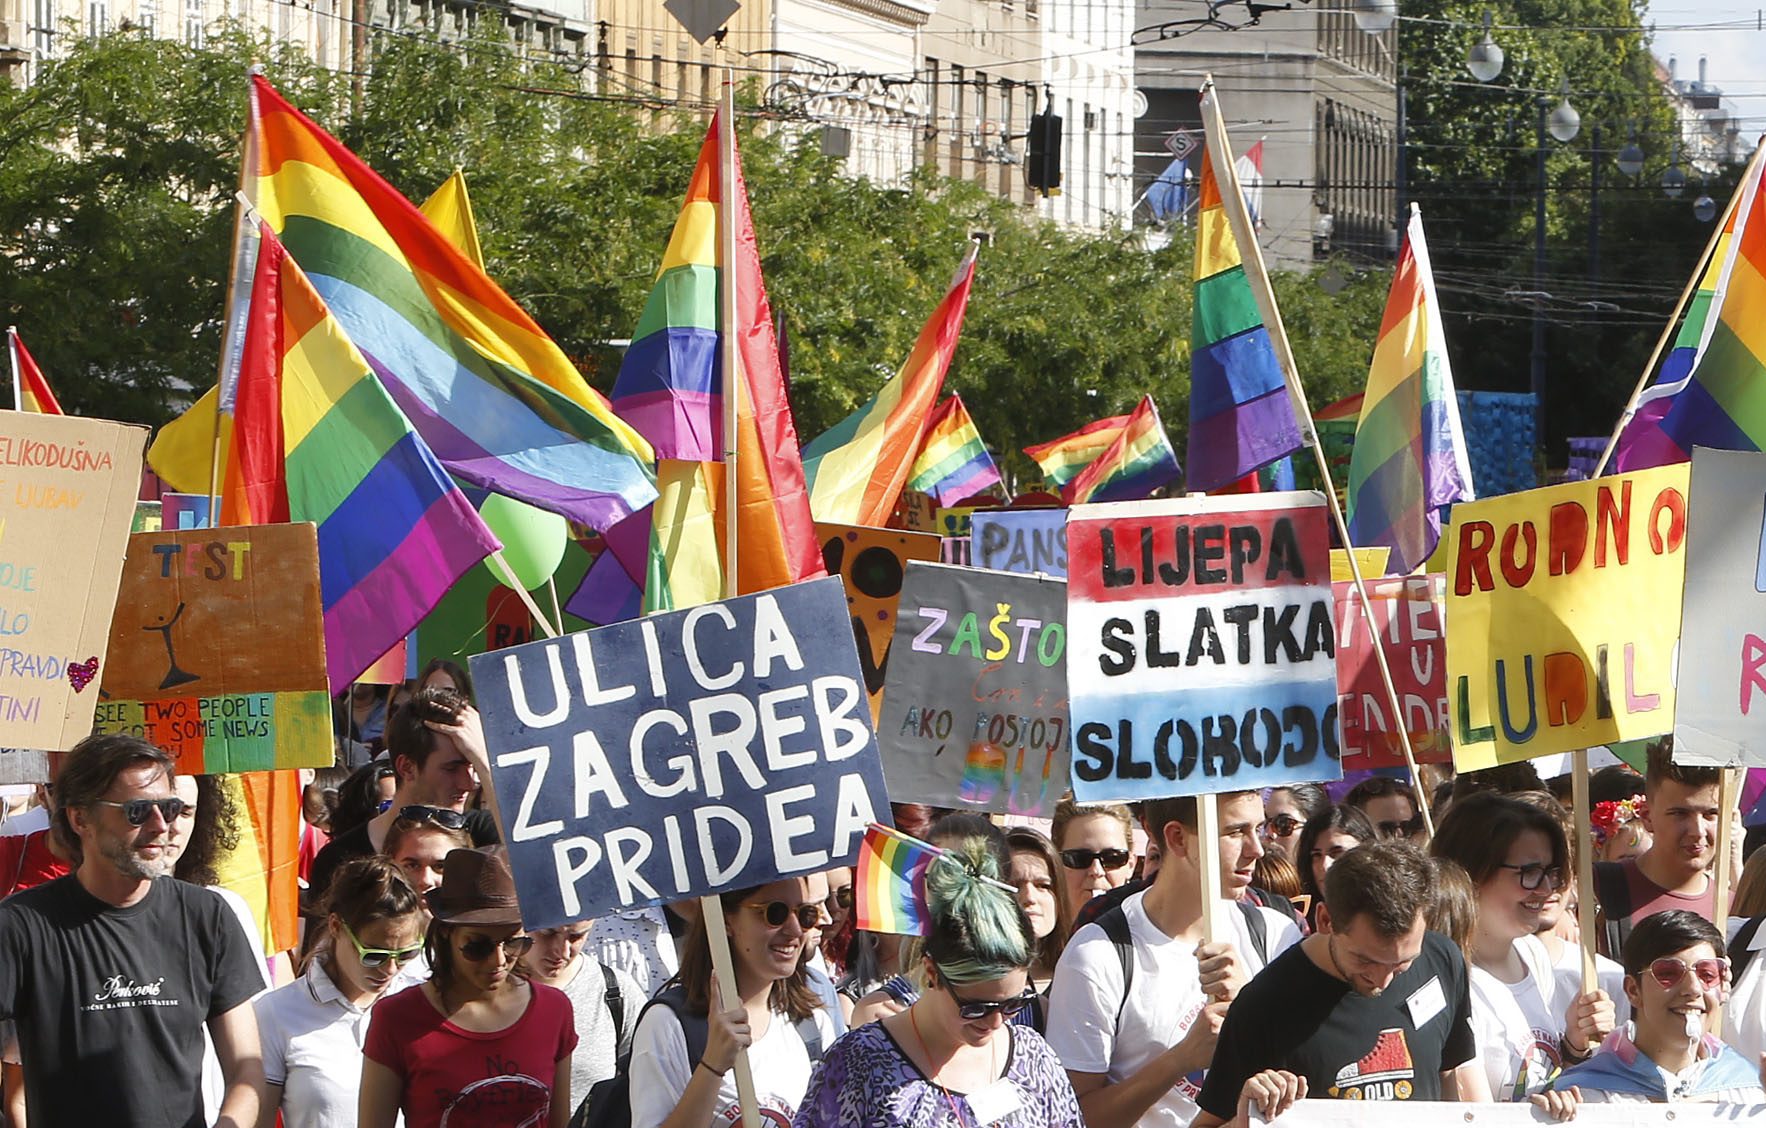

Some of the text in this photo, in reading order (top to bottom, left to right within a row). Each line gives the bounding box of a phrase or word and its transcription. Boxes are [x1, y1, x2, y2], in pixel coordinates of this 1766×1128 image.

[1176, 137, 1186, 151] S
[153, 541, 252, 581] TEST
[1101, 518, 1302, 587] LIJEPA
[1455, 480, 1687, 596] RODNO
[504, 594, 804, 728] ULICA
[910, 602, 1065, 667] ZAŠTO
[1099, 600, 1334, 676] SLATKA
[138, 702, 187, 721] TWO
[199, 697, 270, 718] PEOPLE
[170, 720, 216, 742] SOME
[222, 720, 269, 739] NEWS
[900, 705, 953, 740] AKO
[496, 675, 869, 842] ZAGREB
[553, 773, 879, 917] PRIDEA
[1364, 1081, 1394, 1100] OLD
